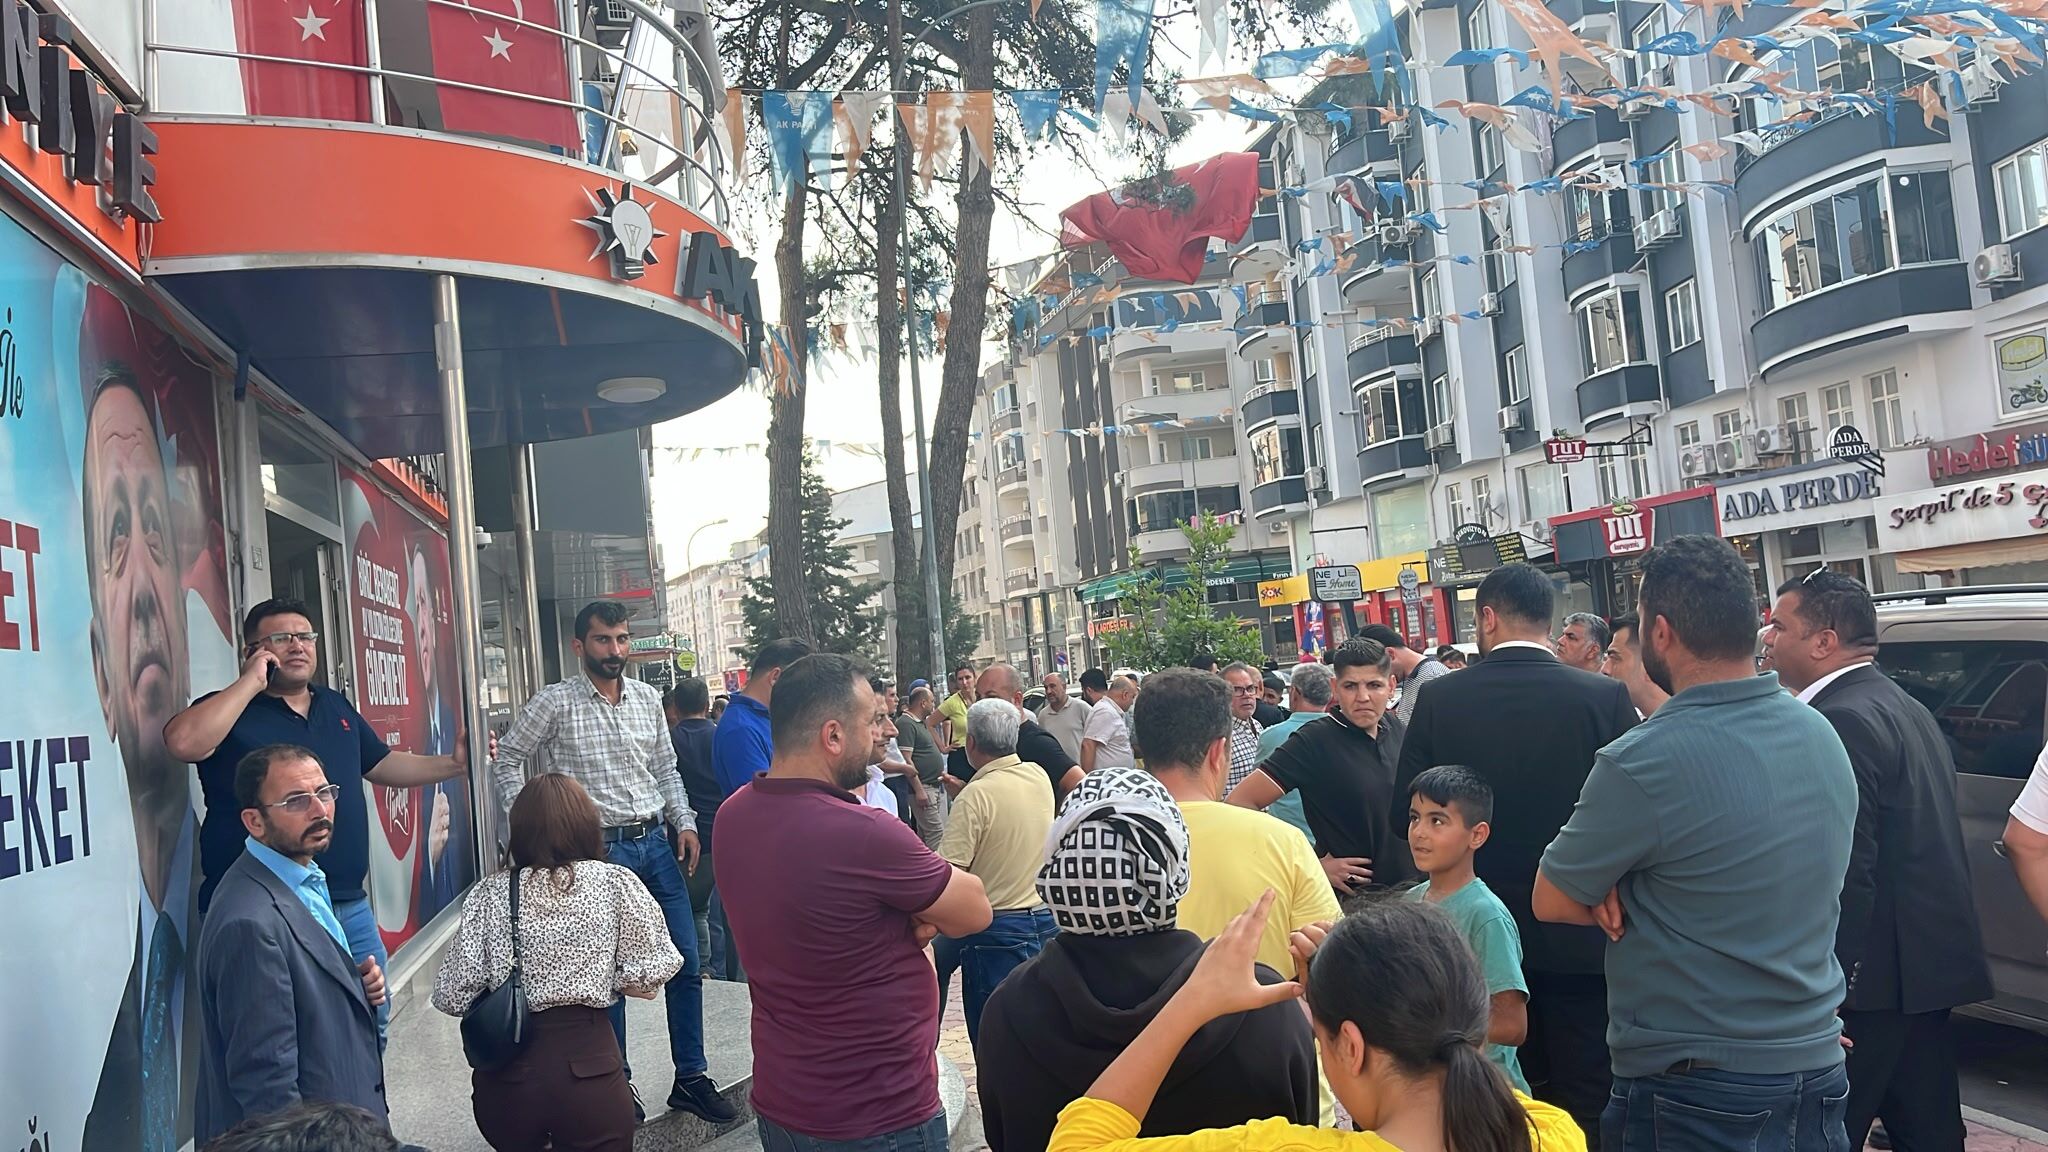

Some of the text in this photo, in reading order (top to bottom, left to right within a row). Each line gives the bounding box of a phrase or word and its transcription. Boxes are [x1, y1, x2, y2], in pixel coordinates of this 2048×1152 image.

[775, 119, 789, 129] AK
[1835, 430, 1862, 445] ADA
[1548, 441, 1582, 456] TUT
[1831, 443, 1871, 459] PERDE
[1927, 431, 2020, 481] Hedef
[1722, 469, 1881, 522] ADA PERDE
[1993, 482, 2016, 506] 5
[1603, 512, 1644, 542] TUT
